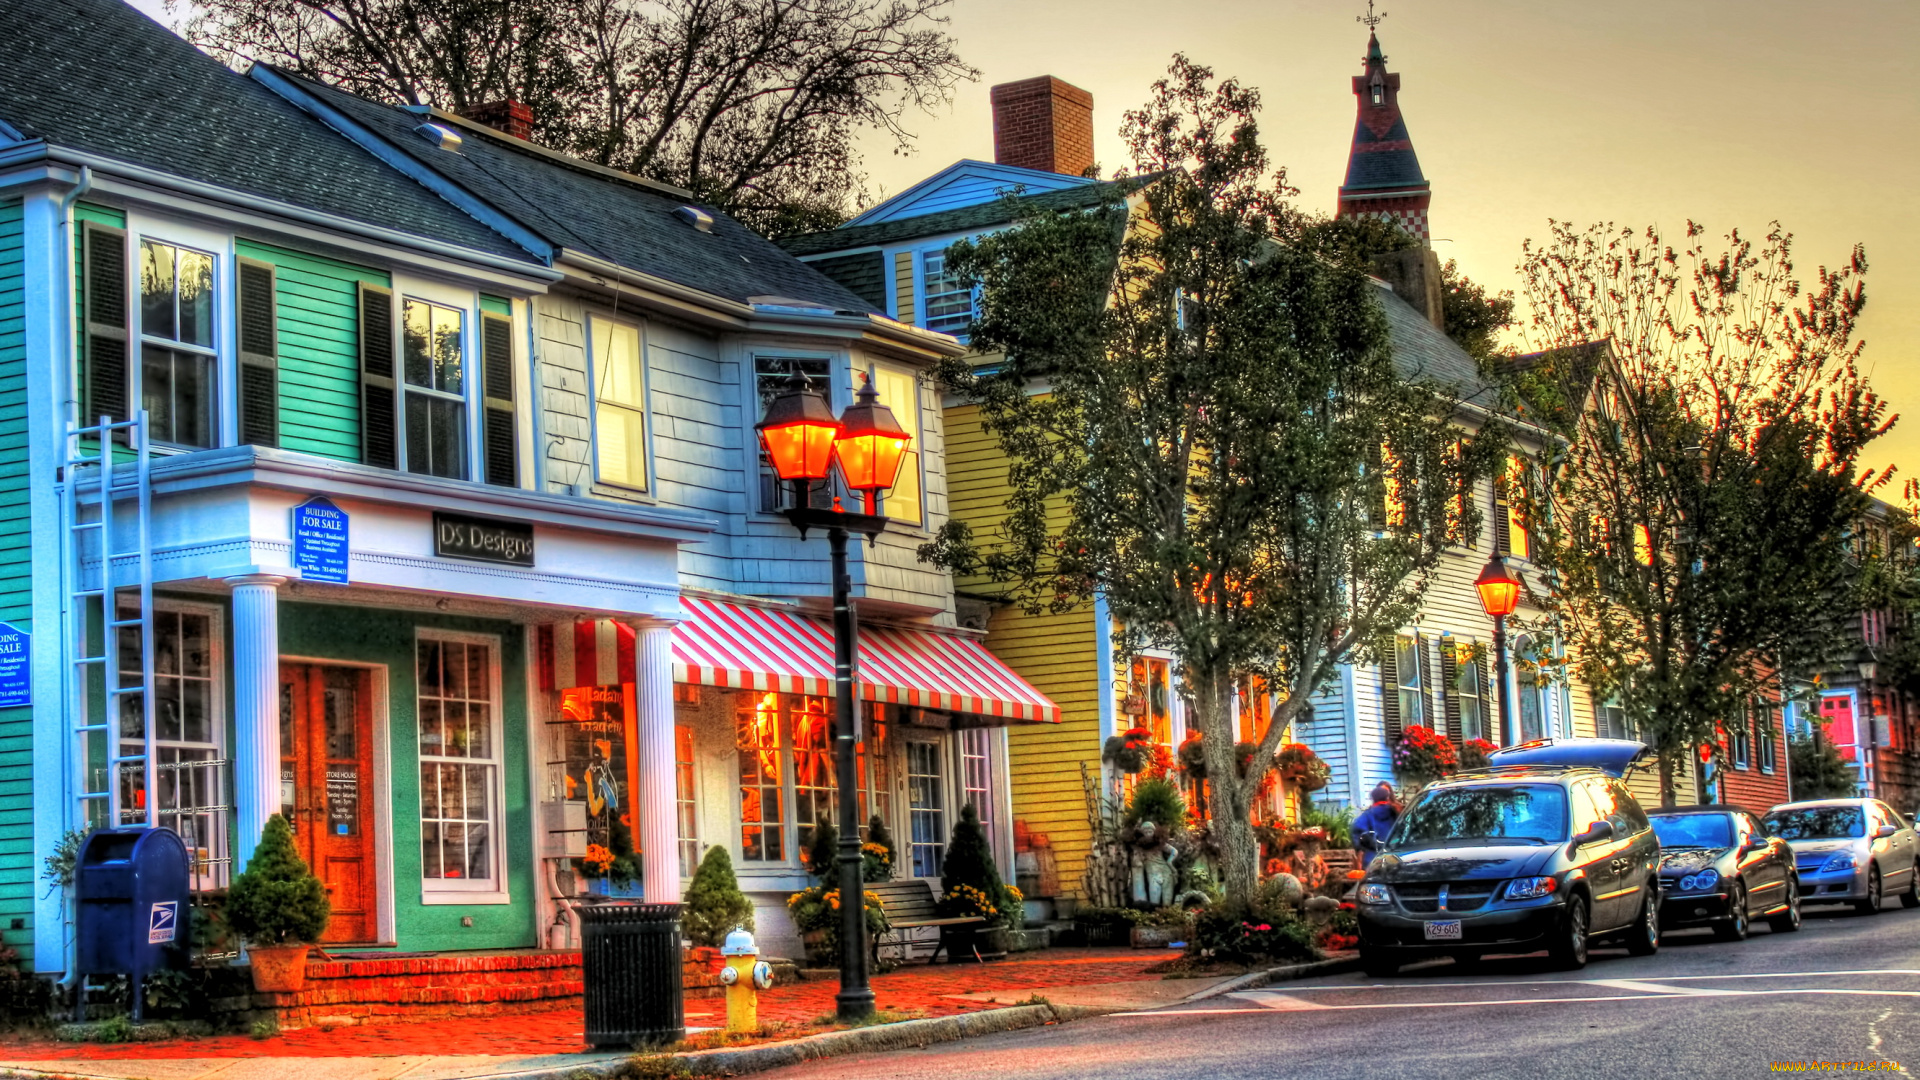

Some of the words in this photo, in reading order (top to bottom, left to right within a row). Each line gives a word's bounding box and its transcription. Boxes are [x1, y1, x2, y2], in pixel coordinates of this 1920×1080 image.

[306, 507, 339, 519] BUILDING
[302, 516, 320, 528] FOR
[322, 519, 342, 530] SALE
[441, 522, 464, 546] DS
[470, 525, 532, 559] Designs
[326, 771, 340, 779] STORE
[1426, 924, 1442, 935] K29
[1444, 924, 1459, 934] 605
